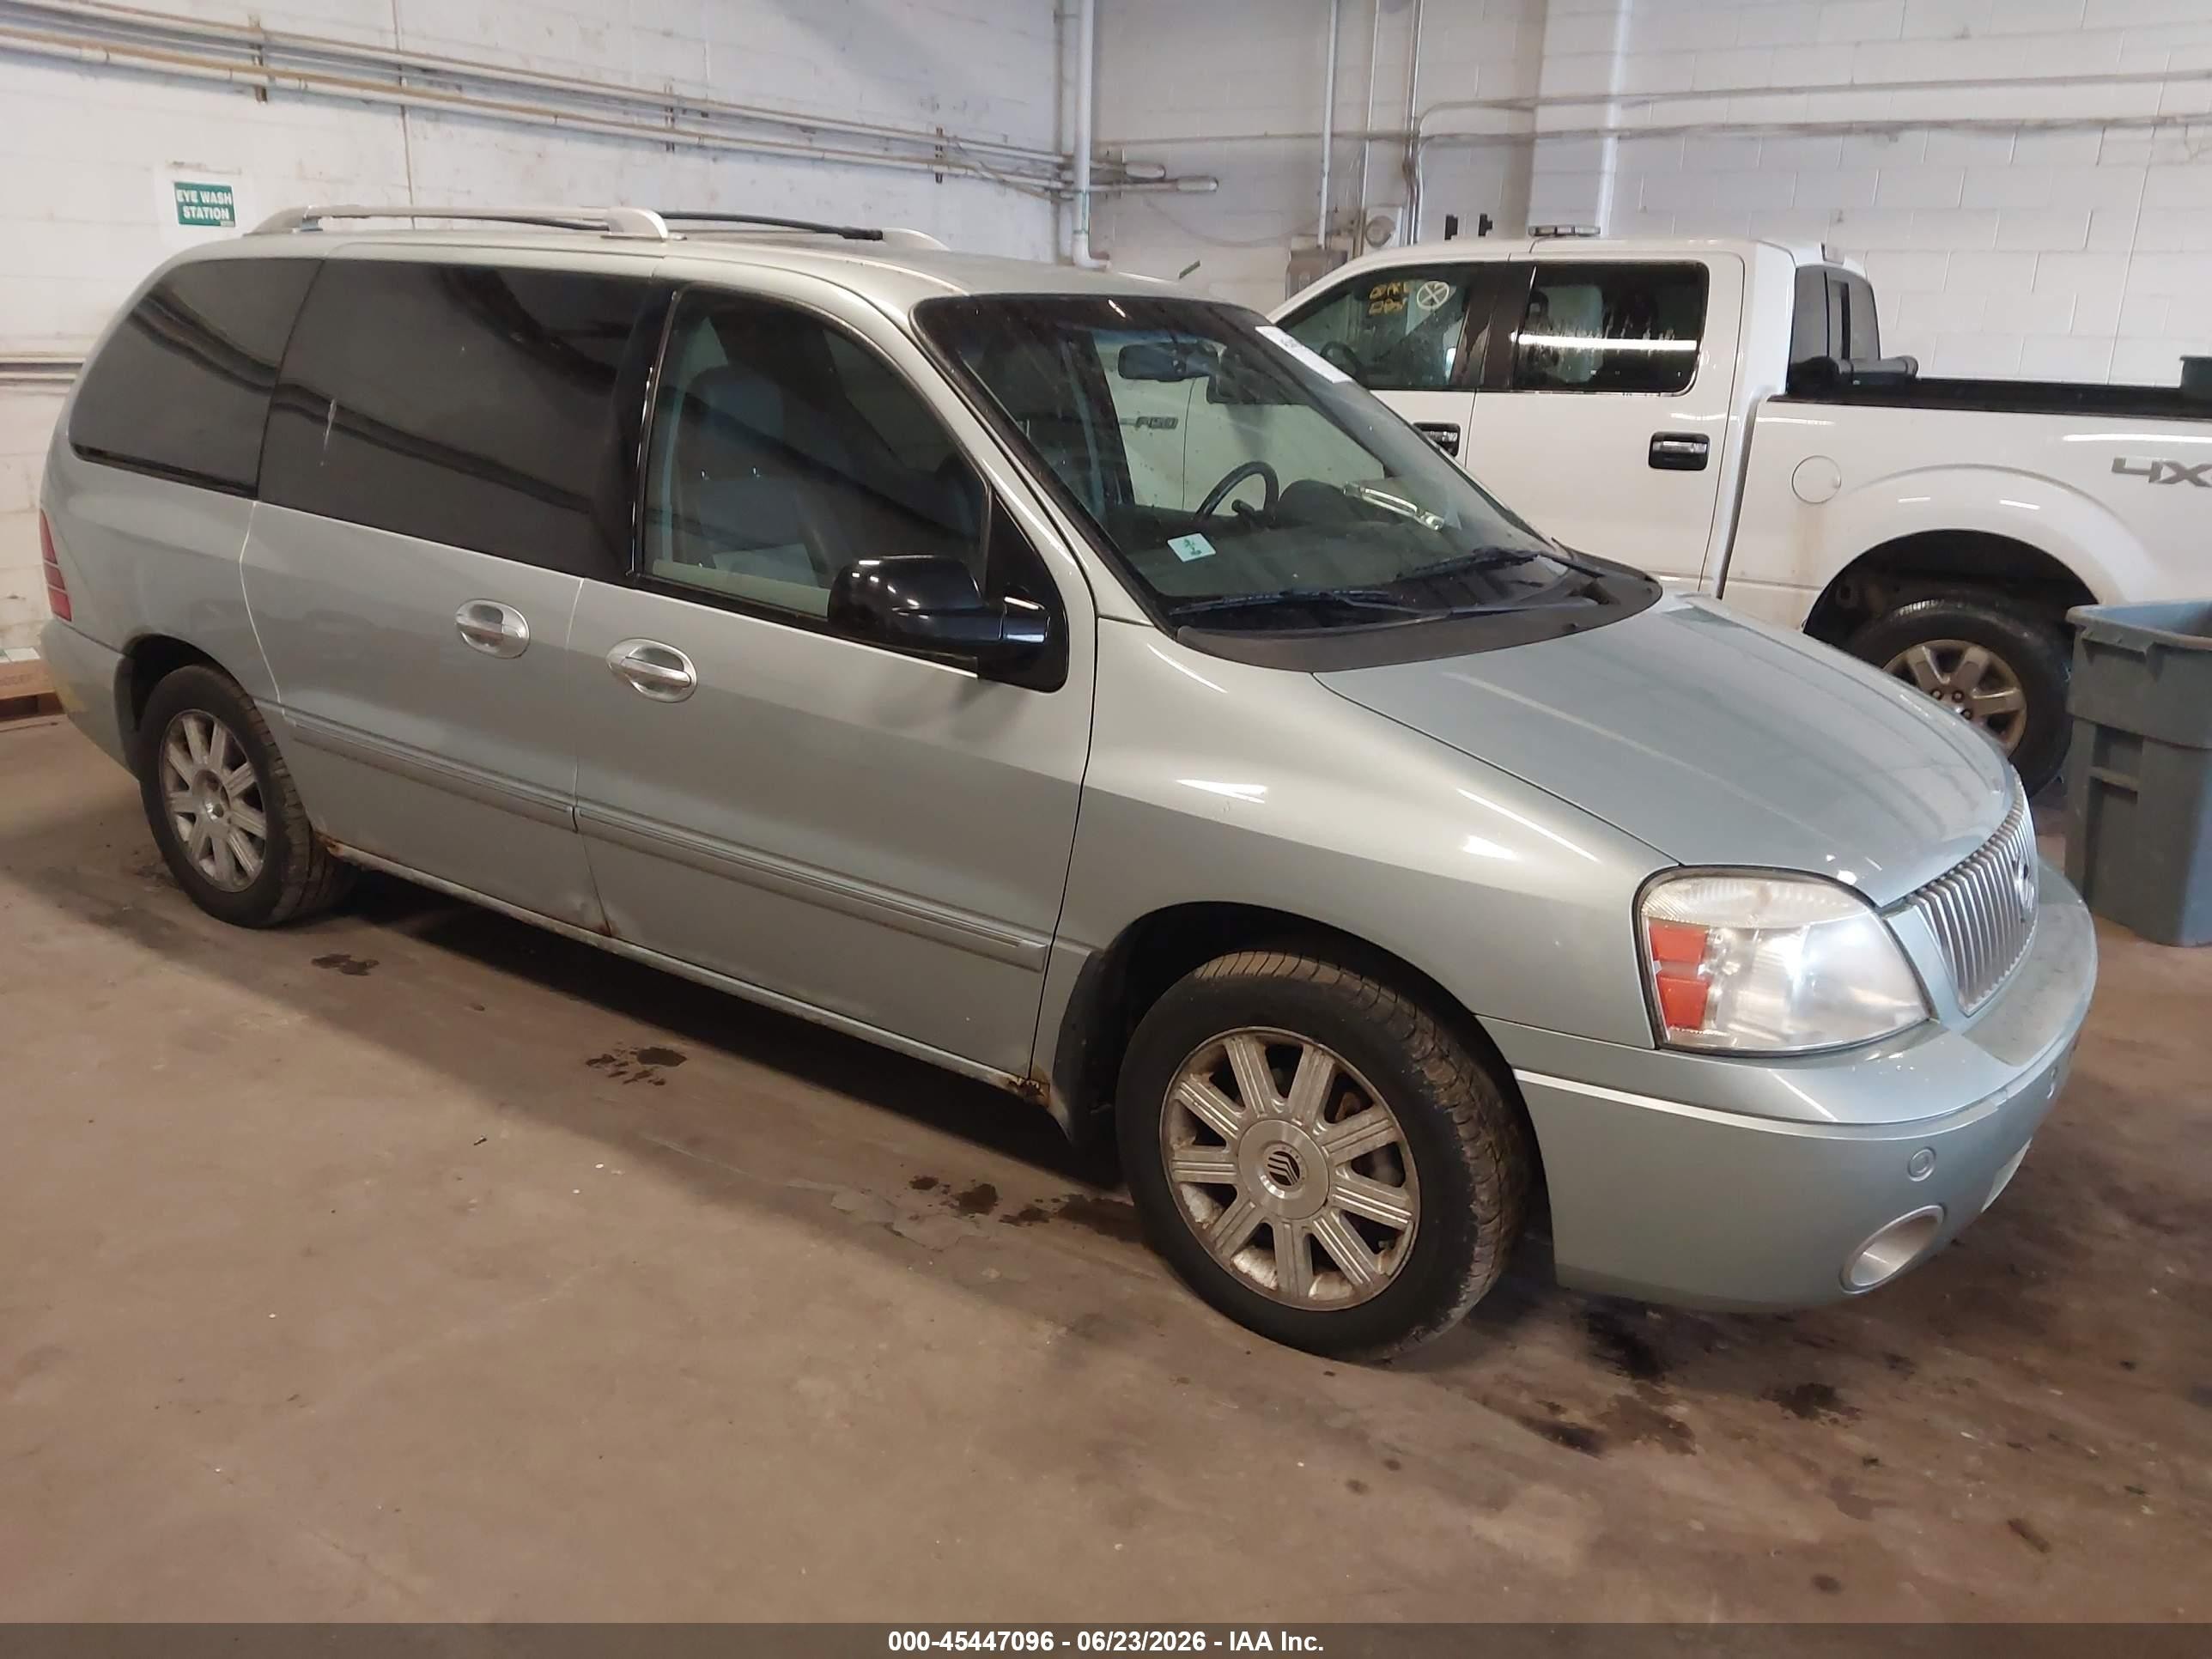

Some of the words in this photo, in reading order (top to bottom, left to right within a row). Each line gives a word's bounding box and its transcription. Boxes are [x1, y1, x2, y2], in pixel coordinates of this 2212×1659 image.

[199, 191, 232, 205] WASH
[183, 205, 229, 220] STATION
[2112, 457, 2212, 488] 4X
